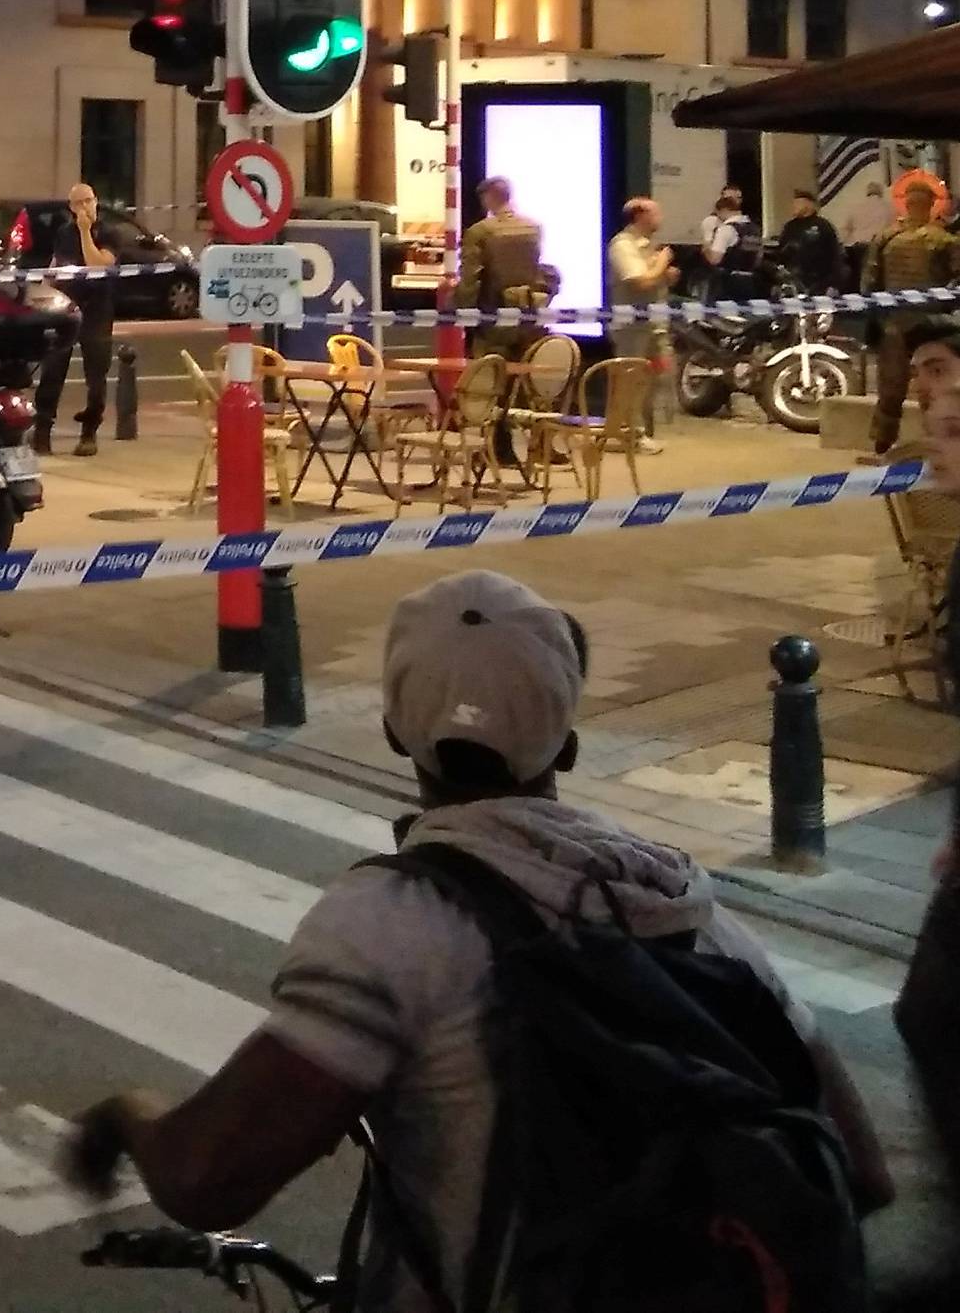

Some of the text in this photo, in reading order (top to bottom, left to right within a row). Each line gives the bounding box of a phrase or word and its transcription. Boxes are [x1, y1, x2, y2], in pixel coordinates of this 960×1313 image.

[333, 533, 368, 549] Police
[156, 548, 198, 564] Politie
[218, 542, 255, 558] Police
[30, 558, 74, 576] Politie
[96, 554, 136, 571] Police
